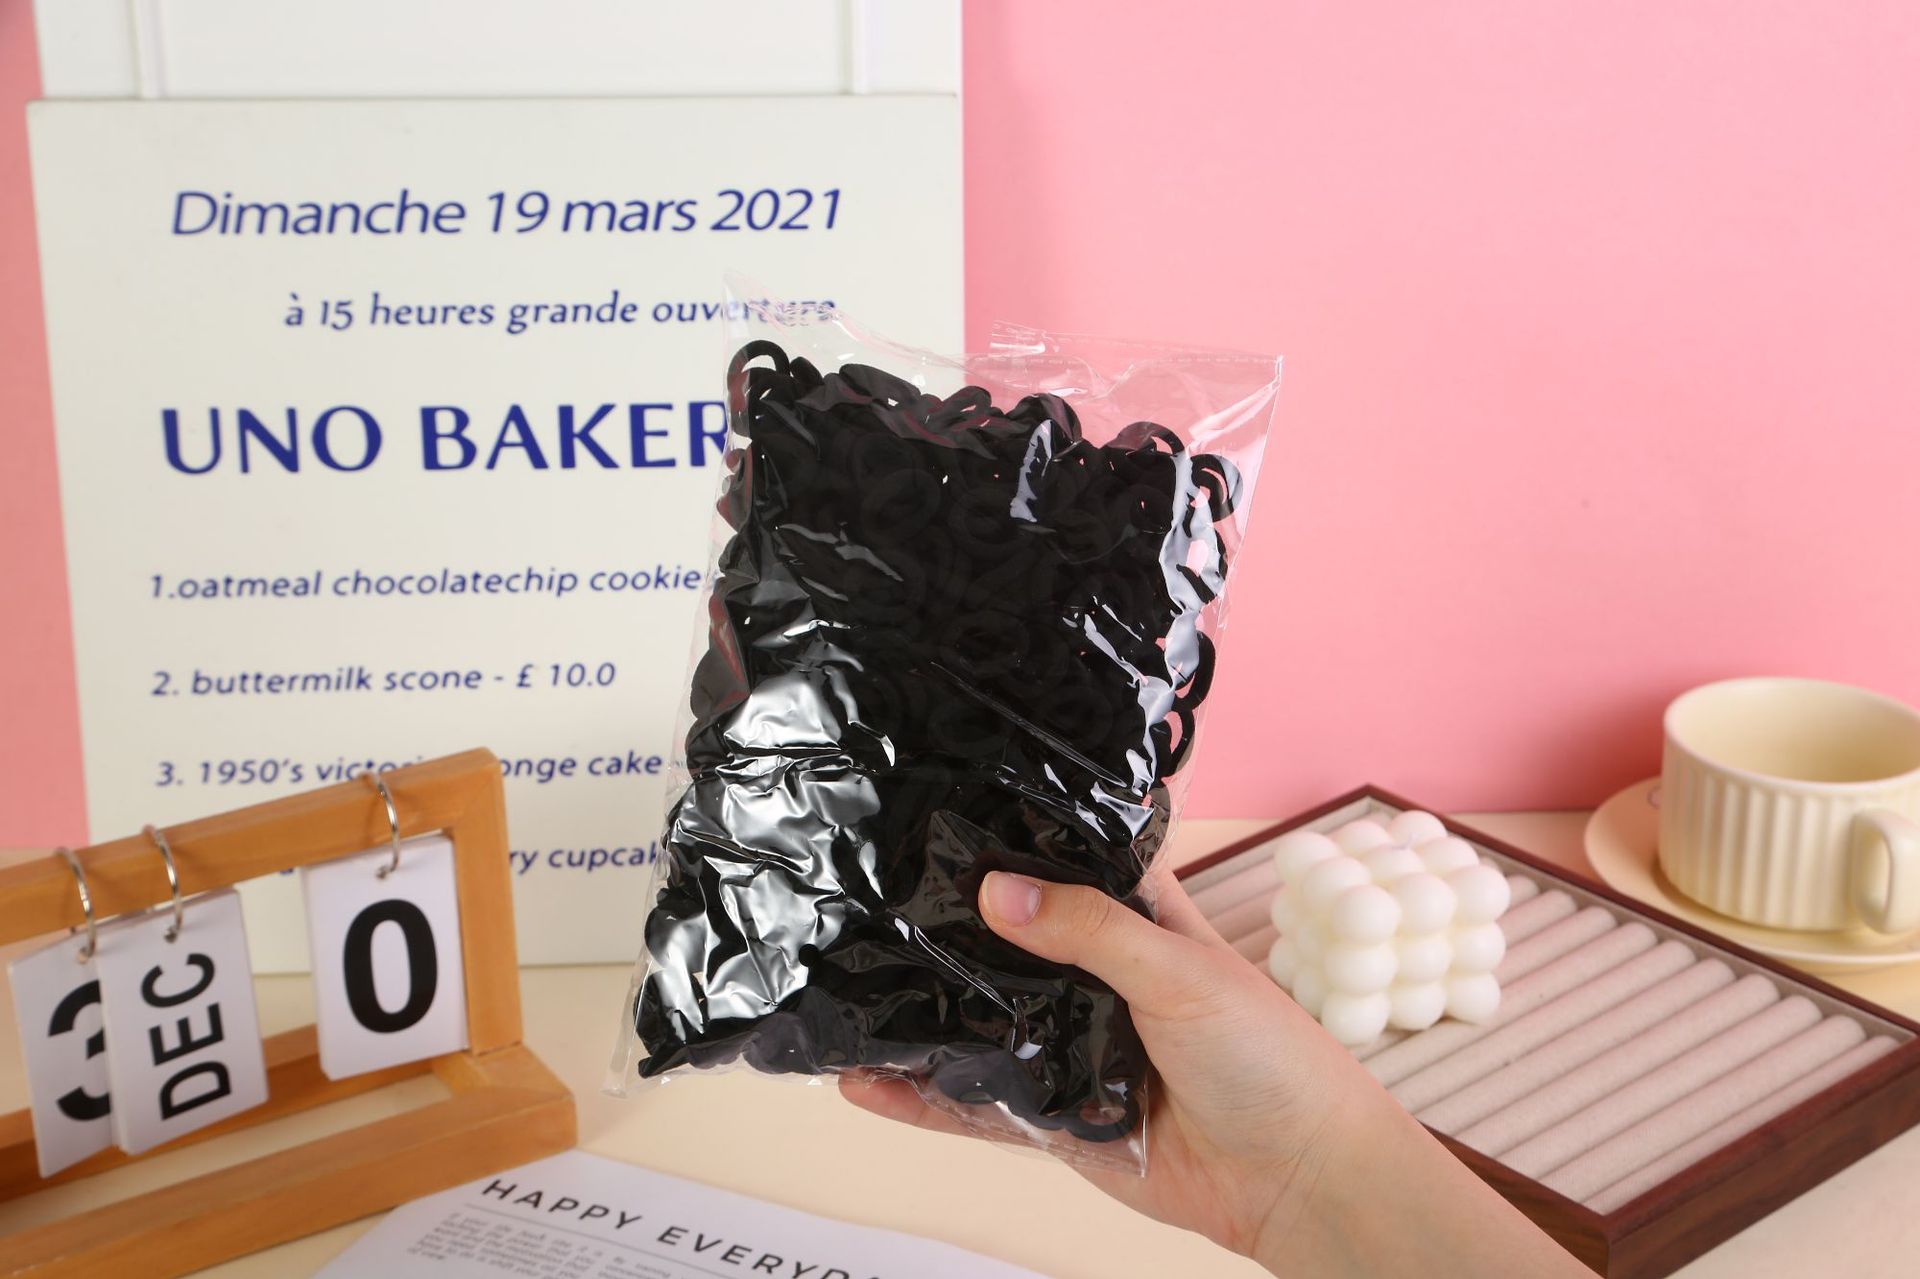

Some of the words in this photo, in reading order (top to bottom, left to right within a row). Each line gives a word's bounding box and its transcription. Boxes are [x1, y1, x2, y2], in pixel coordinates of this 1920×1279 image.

[171, 188, 467, 236] Dimanche
[487, 190, 550, 234] 19
[561, 198, 698, 233] mars
[709, 188, 841, 232] 2021
[284, 292, 305, 327] à
[320, 300, 354, 332] 15
[370, 291, 495, 326] heures
[506, 289, 638, 336] grande
[160, 405, 384, 476] UNO
[418, 400, 728, 473] BAKER
[332, 566, 578, 599] chocolatechip
[589, 564, 703, 592] cookie
[151, 670, 180, 697] 2.
[191, 665, 373, 696] buttermilk
[384, 669, 483, 693] scone
[516, 663, 535, 689] £
[549, 661, 618, 688] 10.0
[155, 761, 184, 788] 3.
[587, 750, 663, 777] cake
[547, 841, 657, 876] cupcak
[343, 898, 438, 1034] 0
[140, 952, 232, 1121] DEC
[481, 1179, 644, 1230] HAPPY
